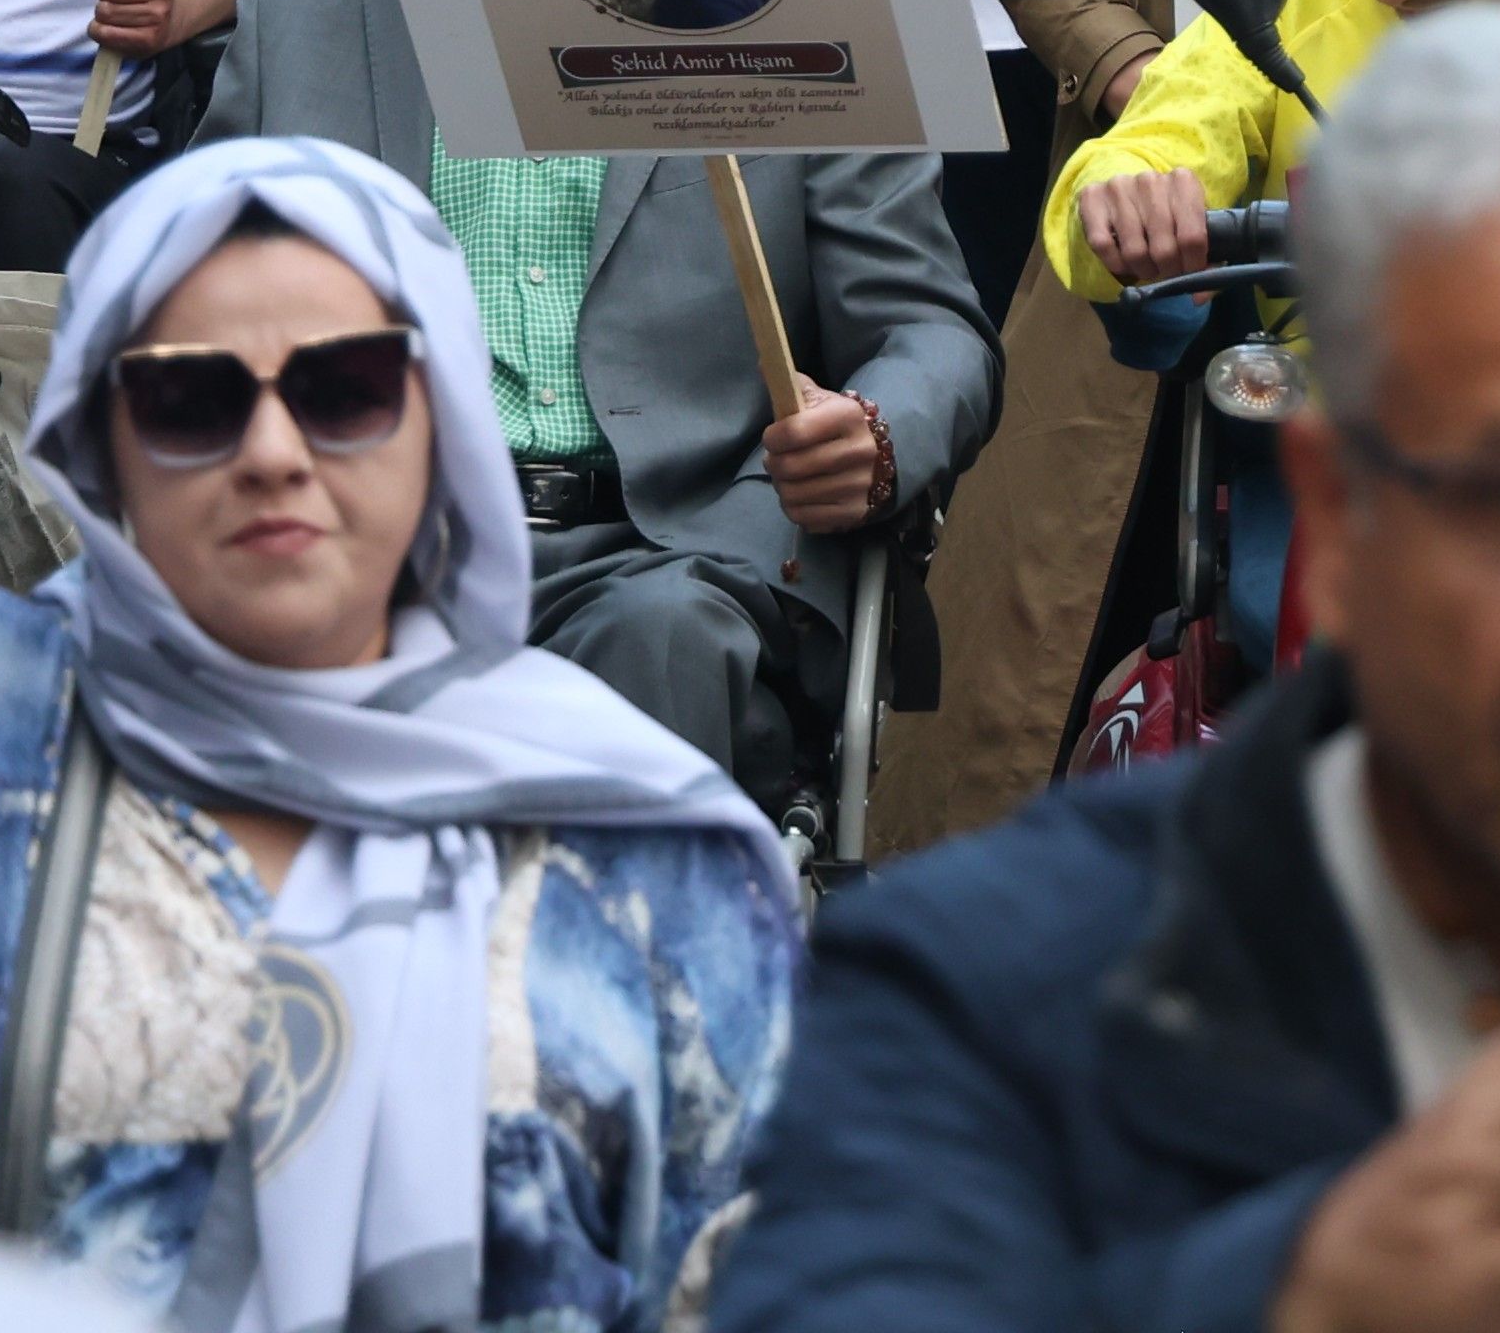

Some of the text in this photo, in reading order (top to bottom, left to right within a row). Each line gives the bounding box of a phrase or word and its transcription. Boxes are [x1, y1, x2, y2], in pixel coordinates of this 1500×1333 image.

[611, 51, 795, 75] Şehid Amir Hişam
